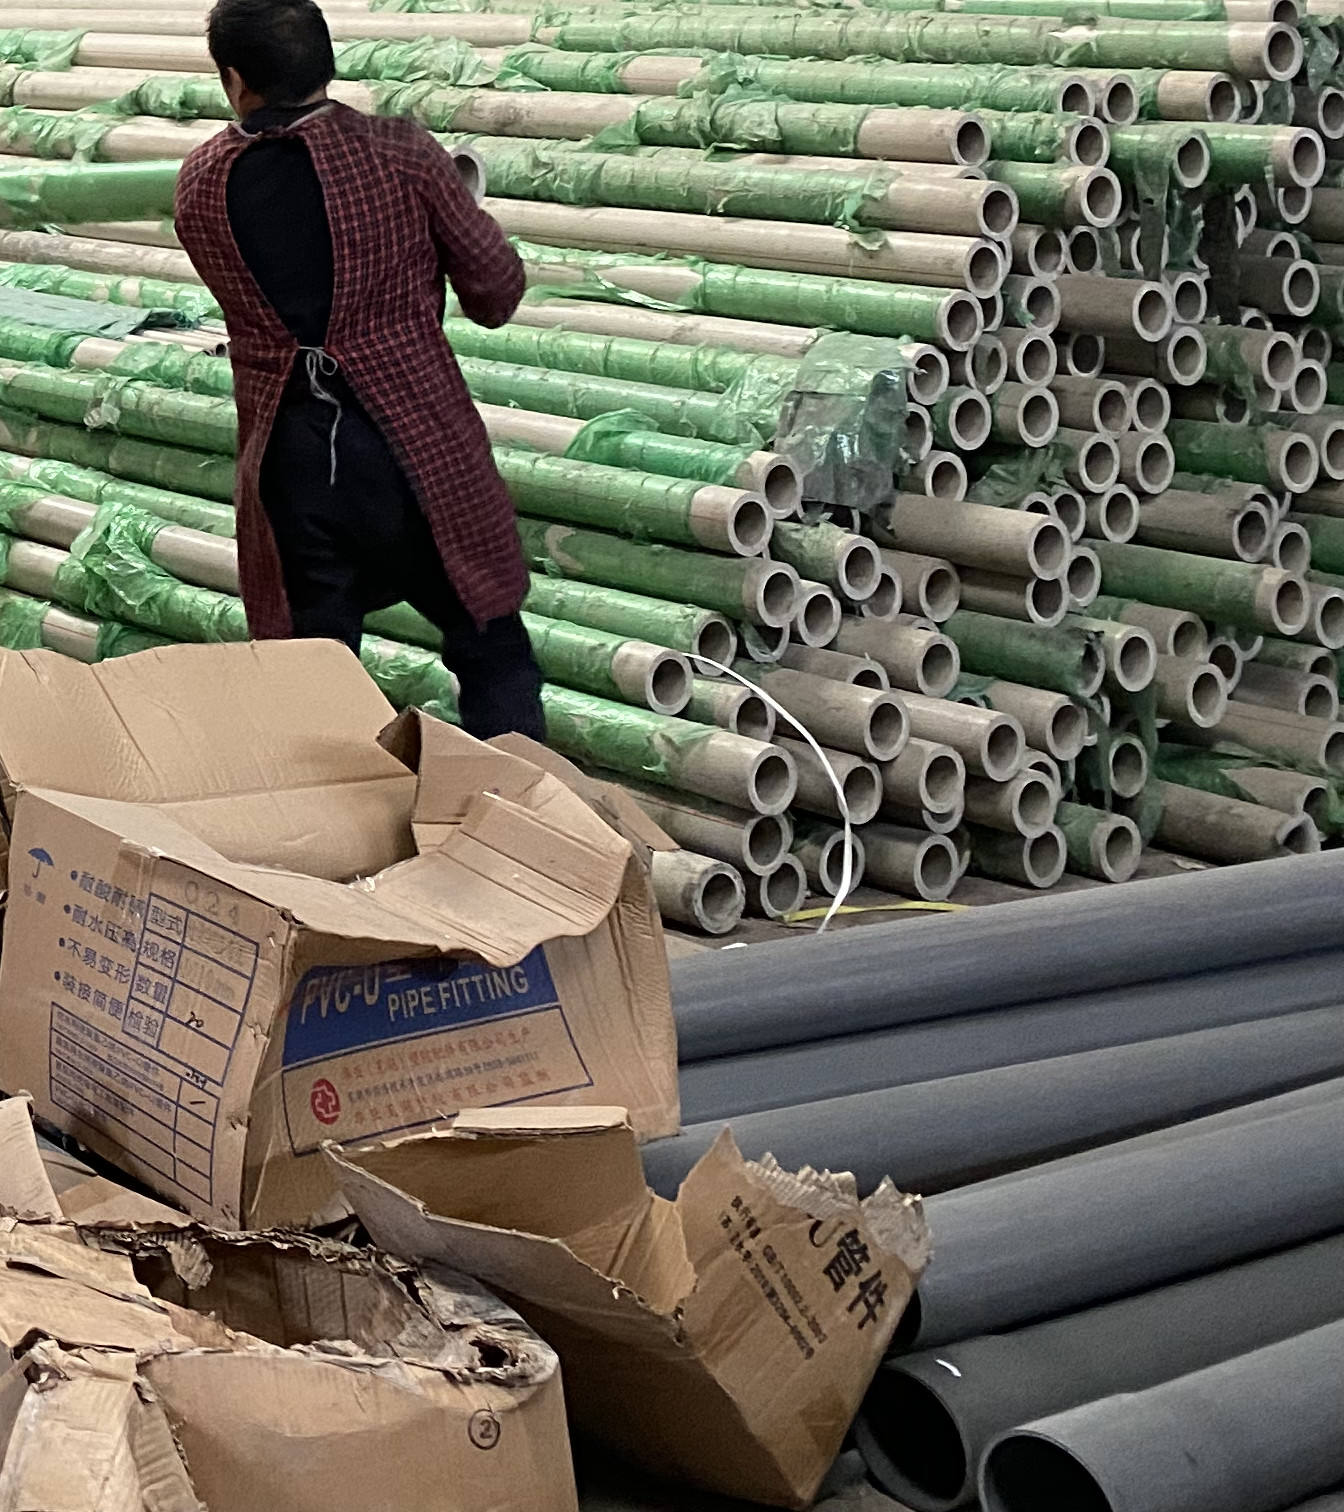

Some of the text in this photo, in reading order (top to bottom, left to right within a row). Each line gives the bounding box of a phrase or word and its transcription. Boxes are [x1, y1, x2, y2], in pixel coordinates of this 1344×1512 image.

[70, 904, 138, 954] 耐水压高
[149, 905, 184, 937] 型式
[66, 937, 132, 985] 不易变形
[142, 940, 177, 970] 规格
[387, 966, 530, 1022] PIPE FITTING
